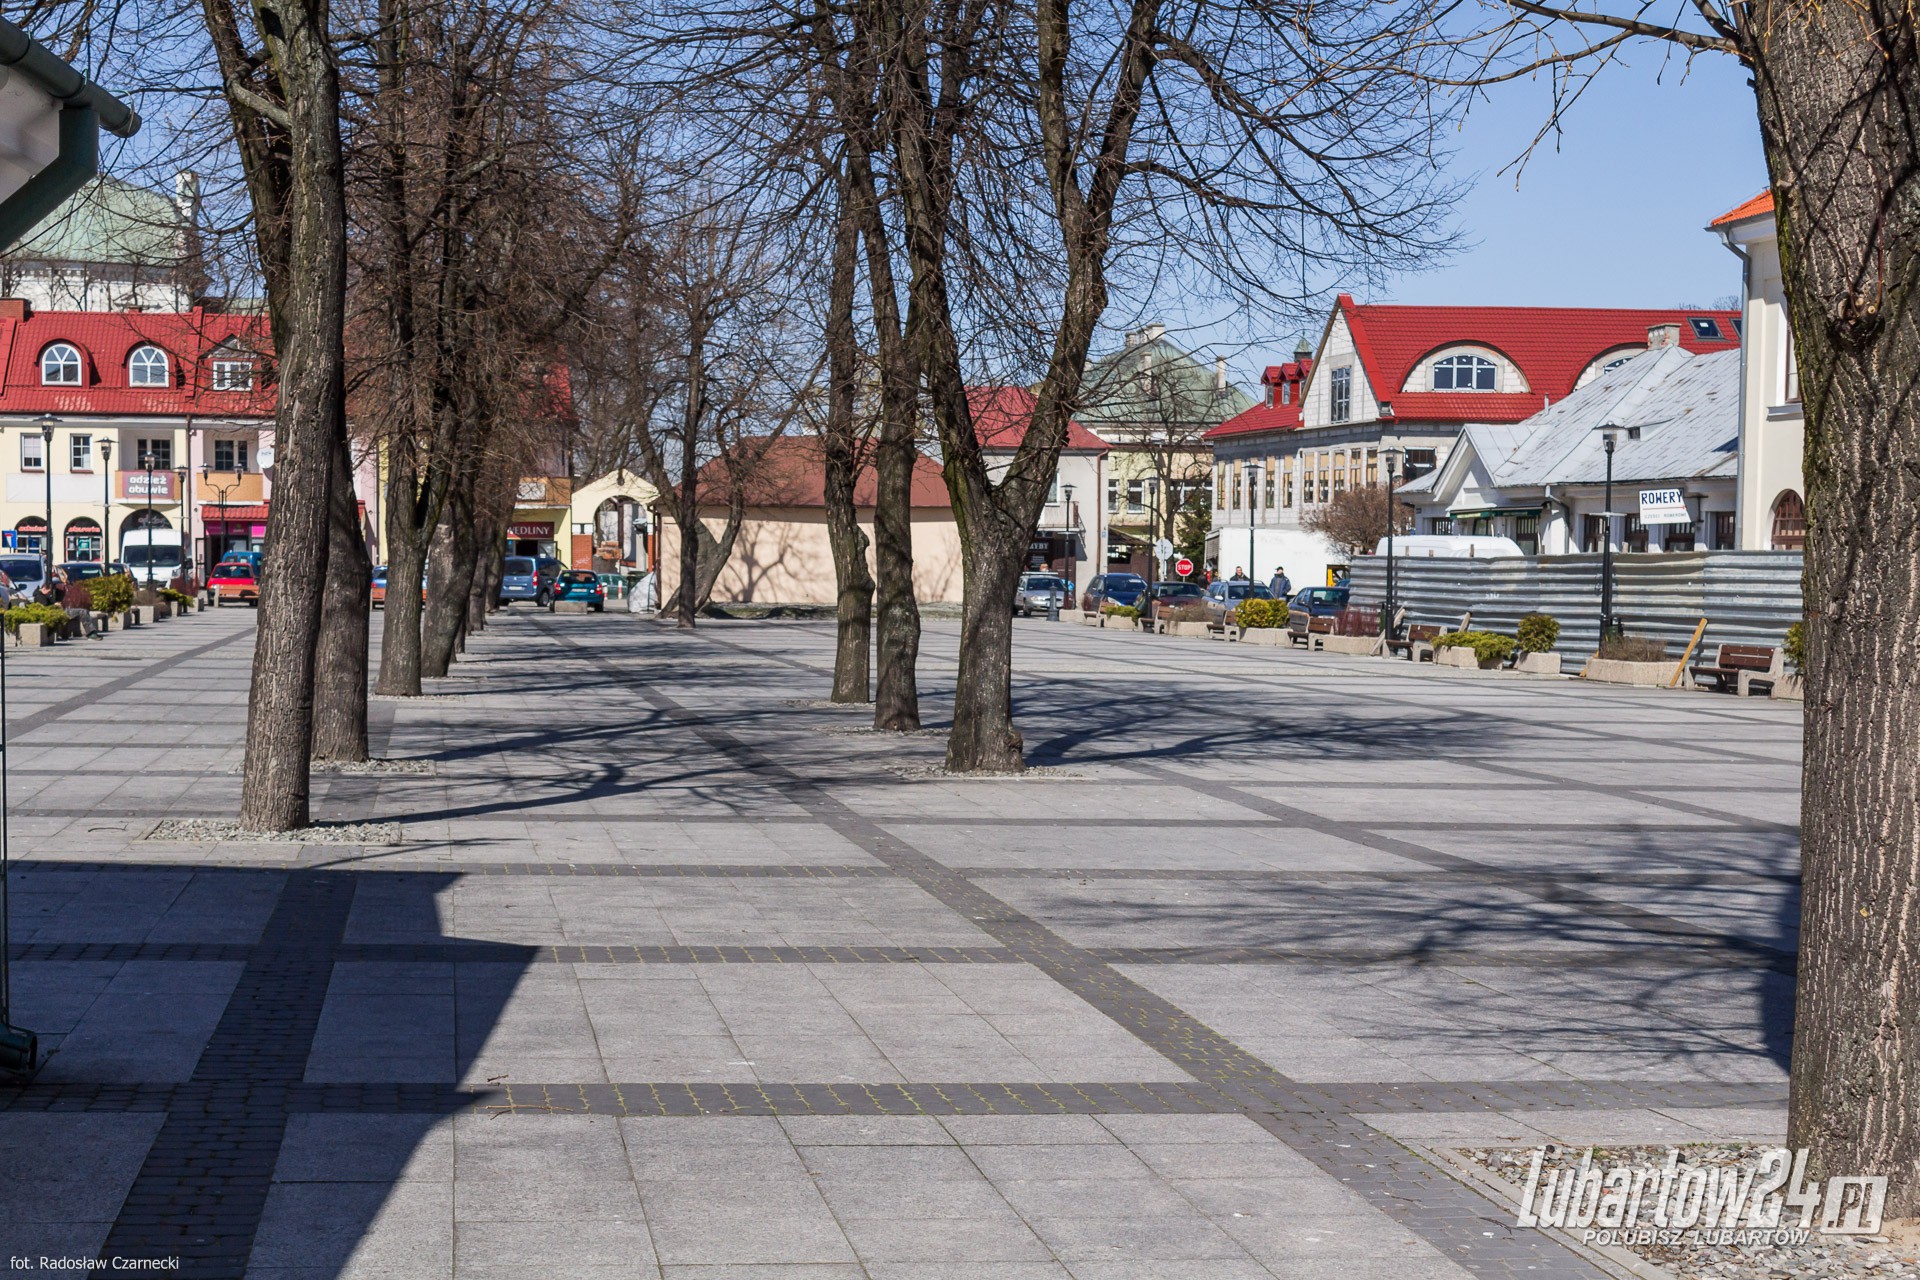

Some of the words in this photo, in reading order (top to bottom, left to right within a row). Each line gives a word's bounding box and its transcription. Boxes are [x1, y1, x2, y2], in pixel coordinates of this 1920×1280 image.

[129, 475, 167, 485] odzież
[128, 485, 169, 495] obuwie
[1641, 491, 1683, 504] ROWERY
